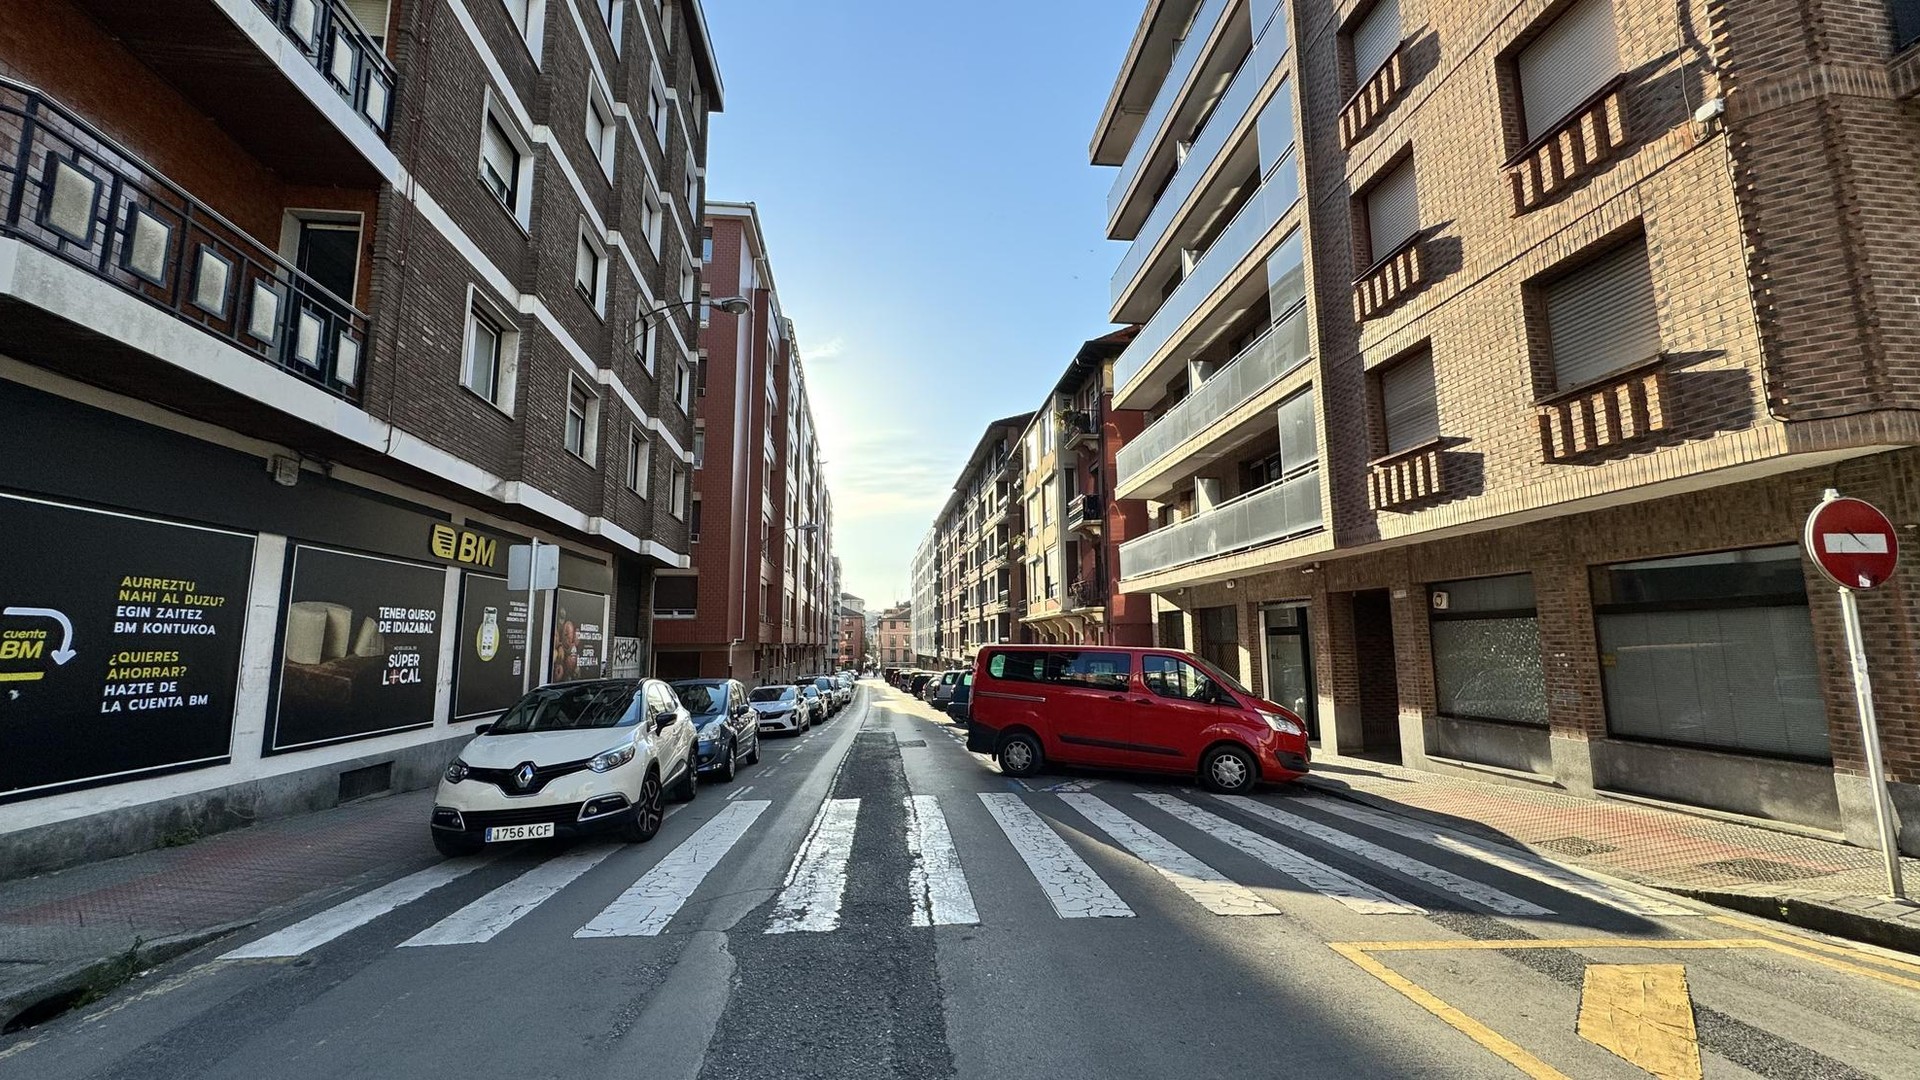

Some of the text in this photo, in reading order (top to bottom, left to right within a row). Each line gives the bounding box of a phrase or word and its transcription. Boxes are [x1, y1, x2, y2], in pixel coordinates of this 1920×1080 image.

[458, 531, 497, 567] BM
[121, 576, 195, 592] AURREZTU
[119, 590, 225, 607] NAHI AL DUZU?
[116, 605, 203, 620] EGIN ZAITEZ
[379, 606, 436, 621] TENER QUESO
[3, 629, 47, 639] cuenta
[114, 622, 216, 635] BM KONTUKOA
[378, 620, 434, 634] DE IDIAZABAL
[0, 640, 44, 659] BM
[108, 651, 179, 666] ¿QUIERES
[388, 651, 420, 668] SÚPER
[106, 666, 187, 680] AHORRAR?
[104, 681, 177, 697] HAZTE DE
[101, 694, 208, 713] LA CUENTA BM
[496, 824, 551, 840] 1756 KCF
